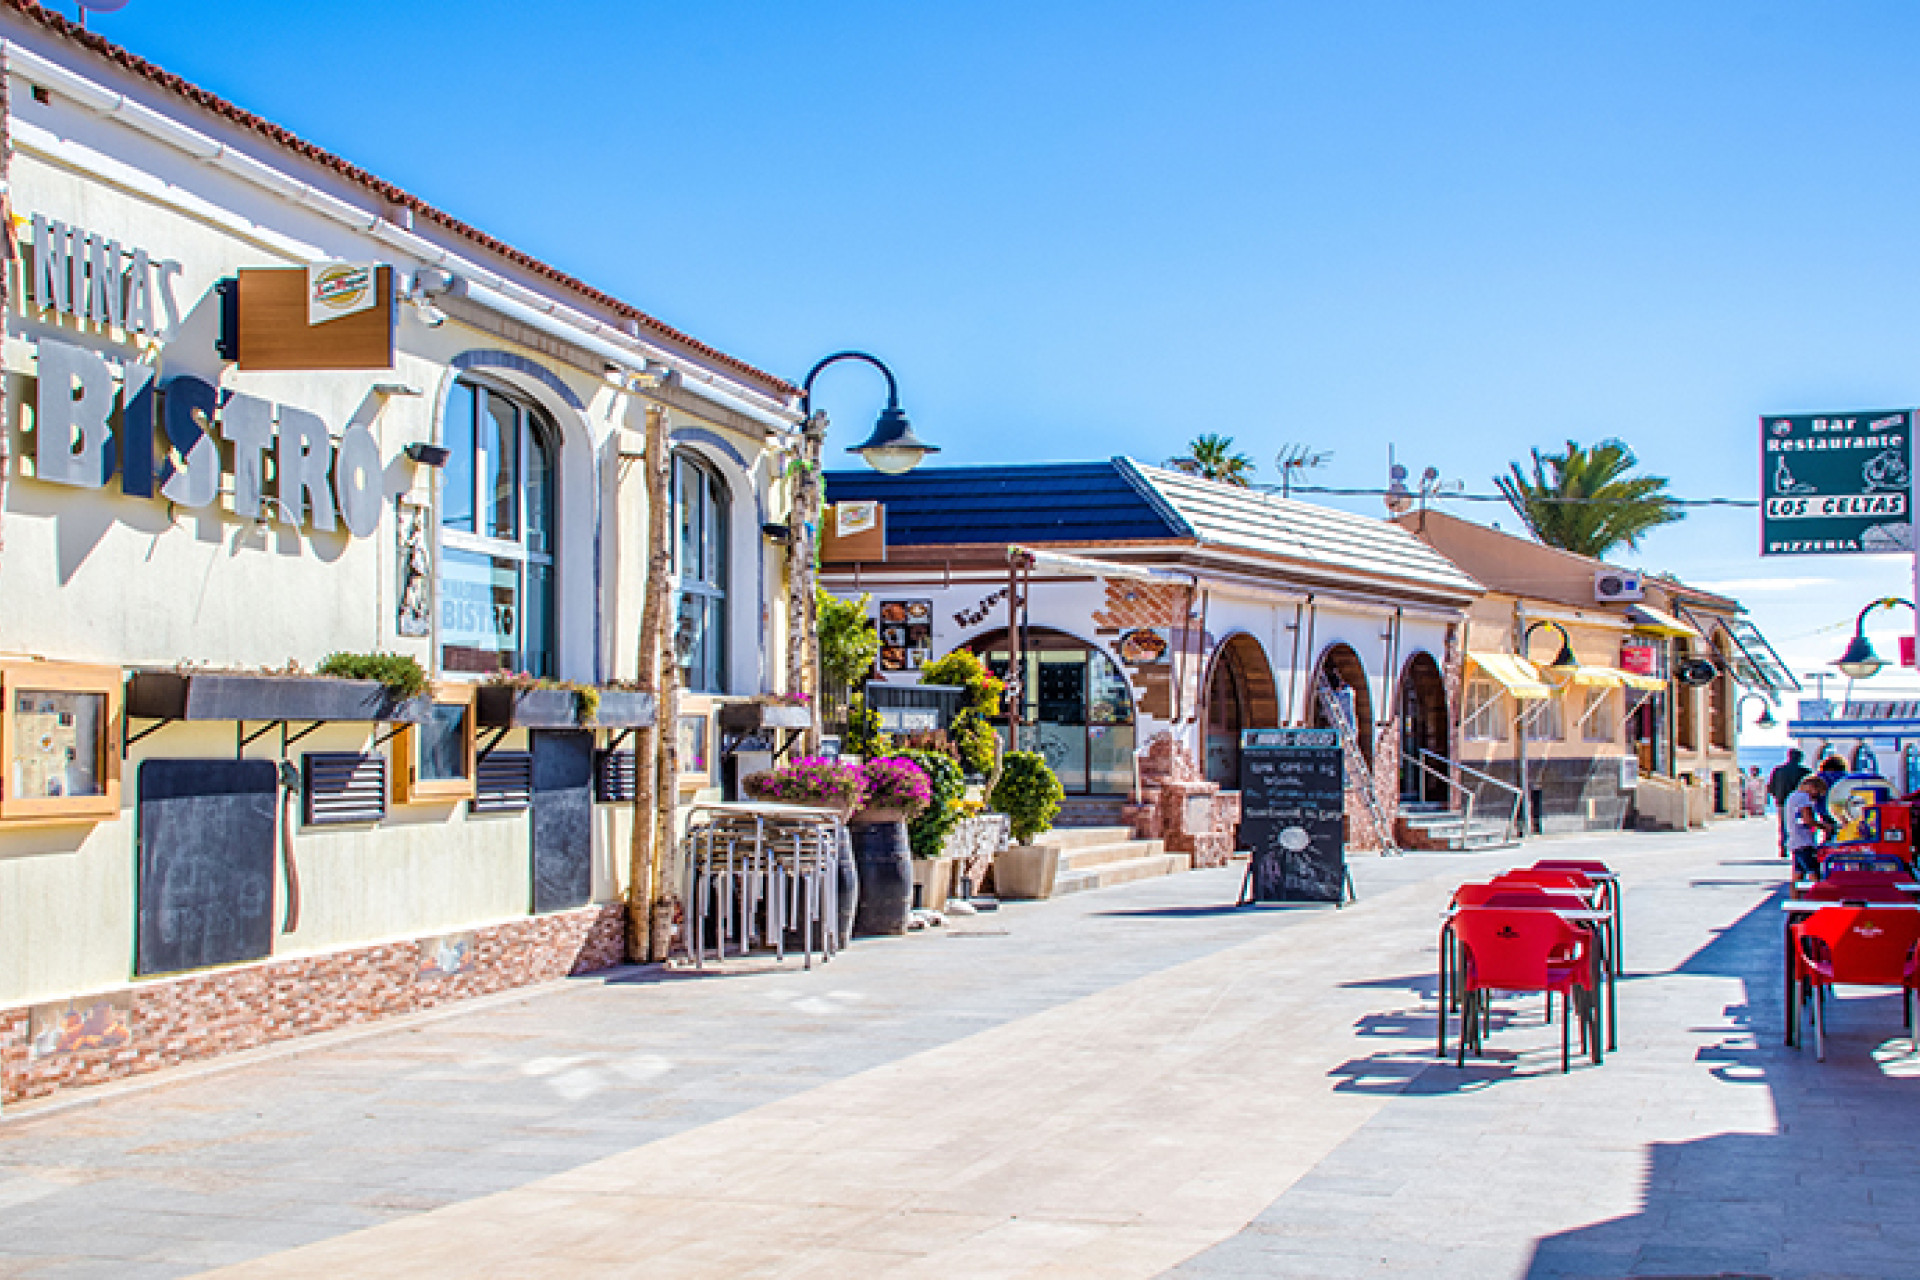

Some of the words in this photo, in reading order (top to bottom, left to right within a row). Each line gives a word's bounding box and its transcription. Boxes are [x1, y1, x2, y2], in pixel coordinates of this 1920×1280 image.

[31, 212, 183, 342] NINAS
[1811, 418, 1857, 432] Bar
[36, 338, 386, 539] BISTRO
[1766, 434, 1905, 452] Restaurante
[1768, 499, 1809, 516] LOS
[1820, 496, 1903, 513] CELTAS
[1769, 539, 1861, 552] PIZZERIA
